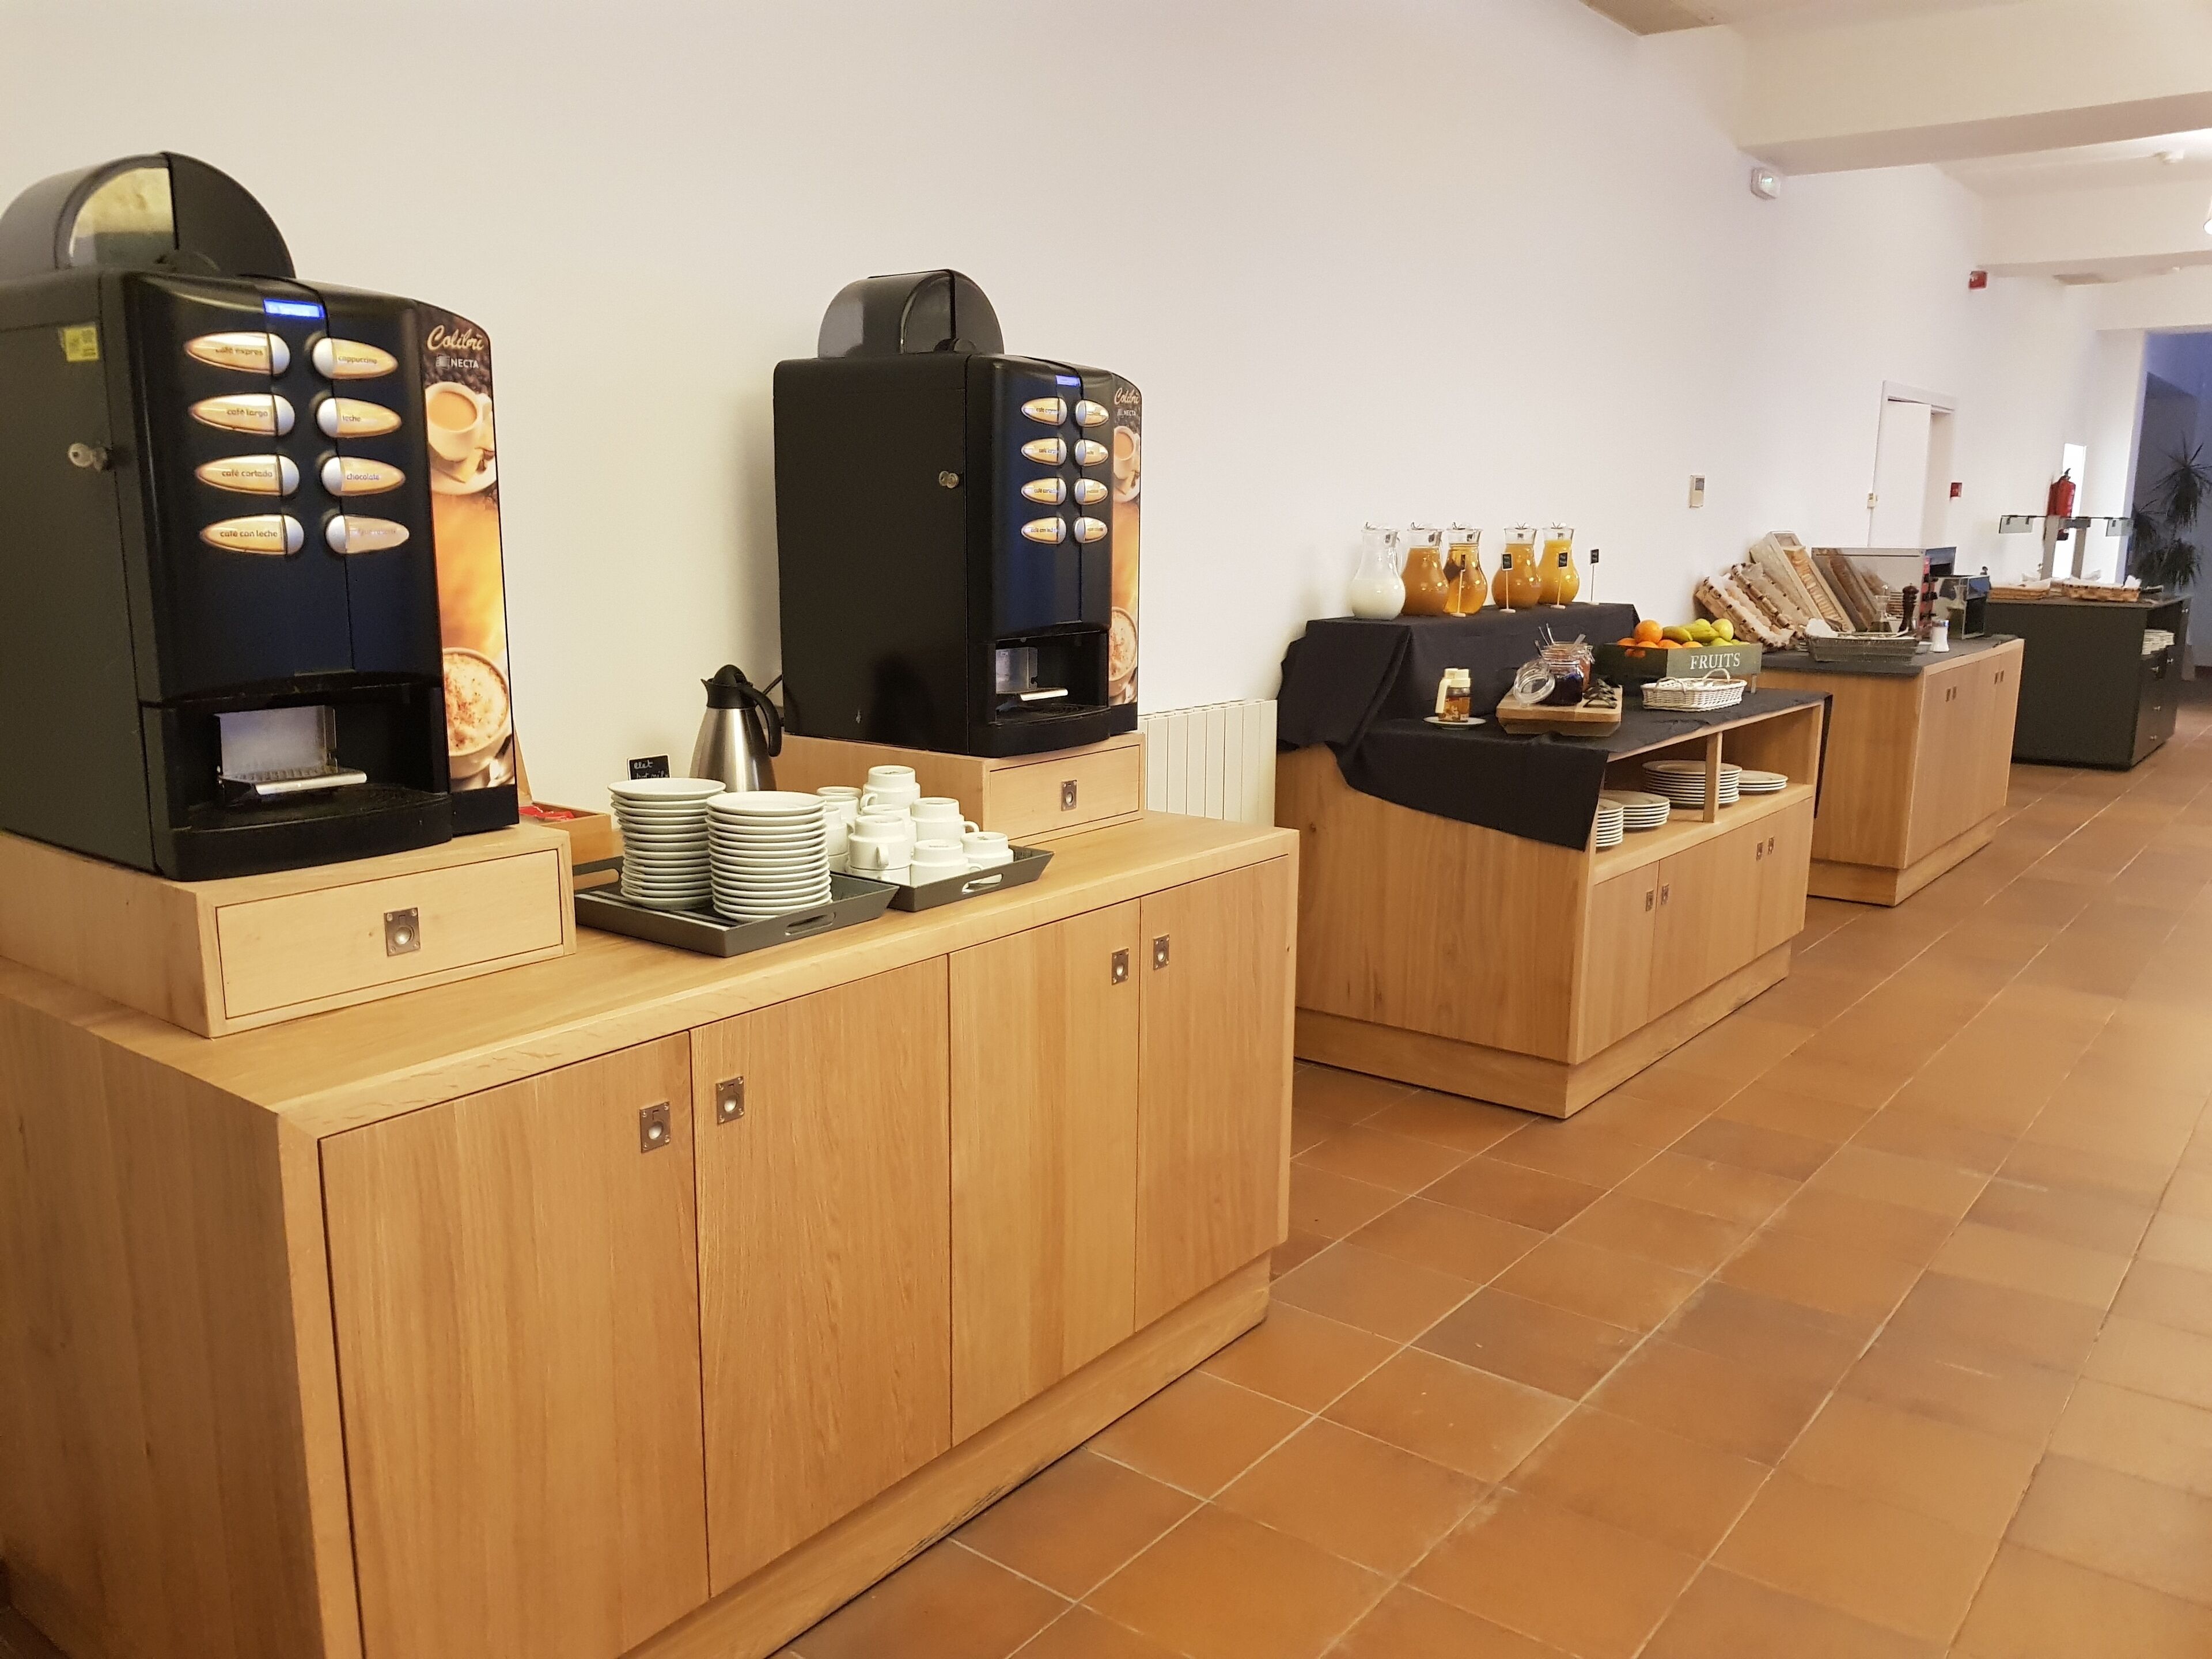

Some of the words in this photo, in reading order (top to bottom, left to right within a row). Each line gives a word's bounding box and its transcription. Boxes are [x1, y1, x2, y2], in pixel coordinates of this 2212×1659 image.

[450, 358, 479, 369] NECTA
[226, 408, 245, 416] café
[246, 408, 268, 418] largo
[221, 469, 240, 478] café
[241, 469, 273, 478] cortado
[346, 473, 380, 481] chocolate
[219, 529, 238, 538] café
[256, 529, 278, 538] leche
[1690, 652, 1741, 670] FRUITS
